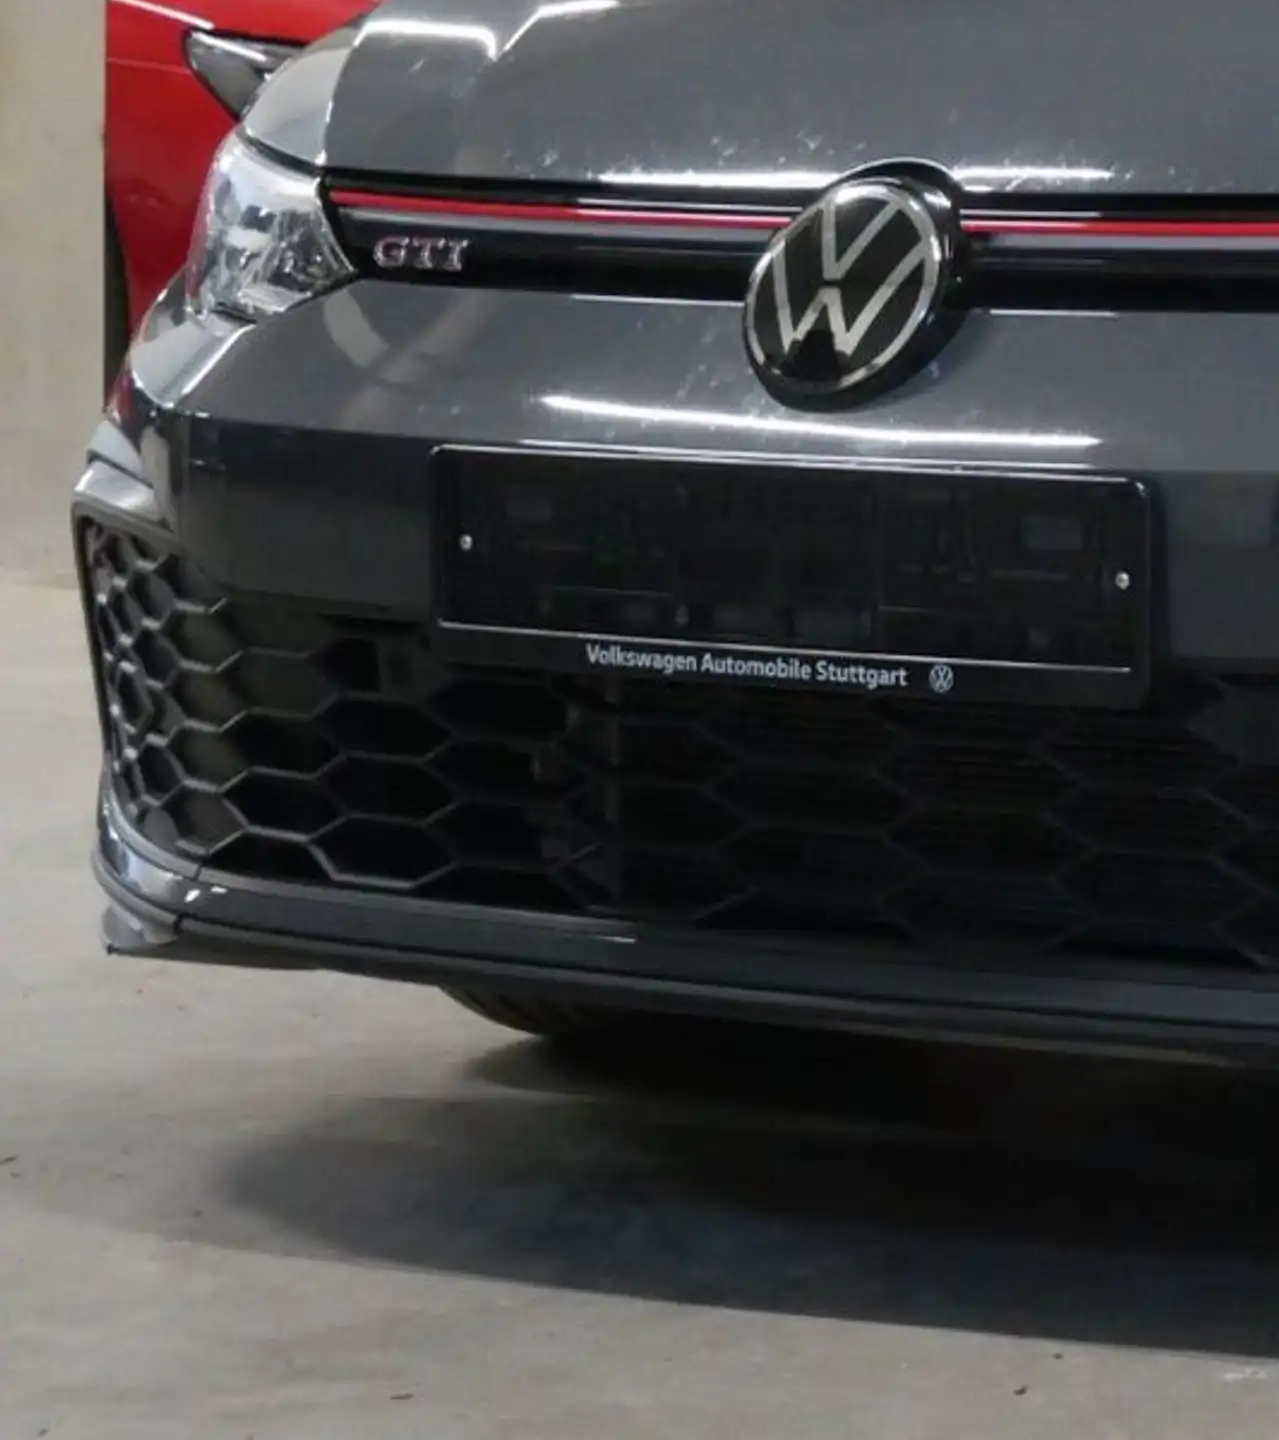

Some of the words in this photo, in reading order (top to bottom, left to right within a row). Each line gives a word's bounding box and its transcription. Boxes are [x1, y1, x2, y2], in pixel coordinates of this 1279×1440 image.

[373, 236, 468, 272] GTI
[585, 643, 698, 677] Volkswagen
[700, 652, 812, 682] Automobile
[815, 659, 909, 691] Stuttgart
